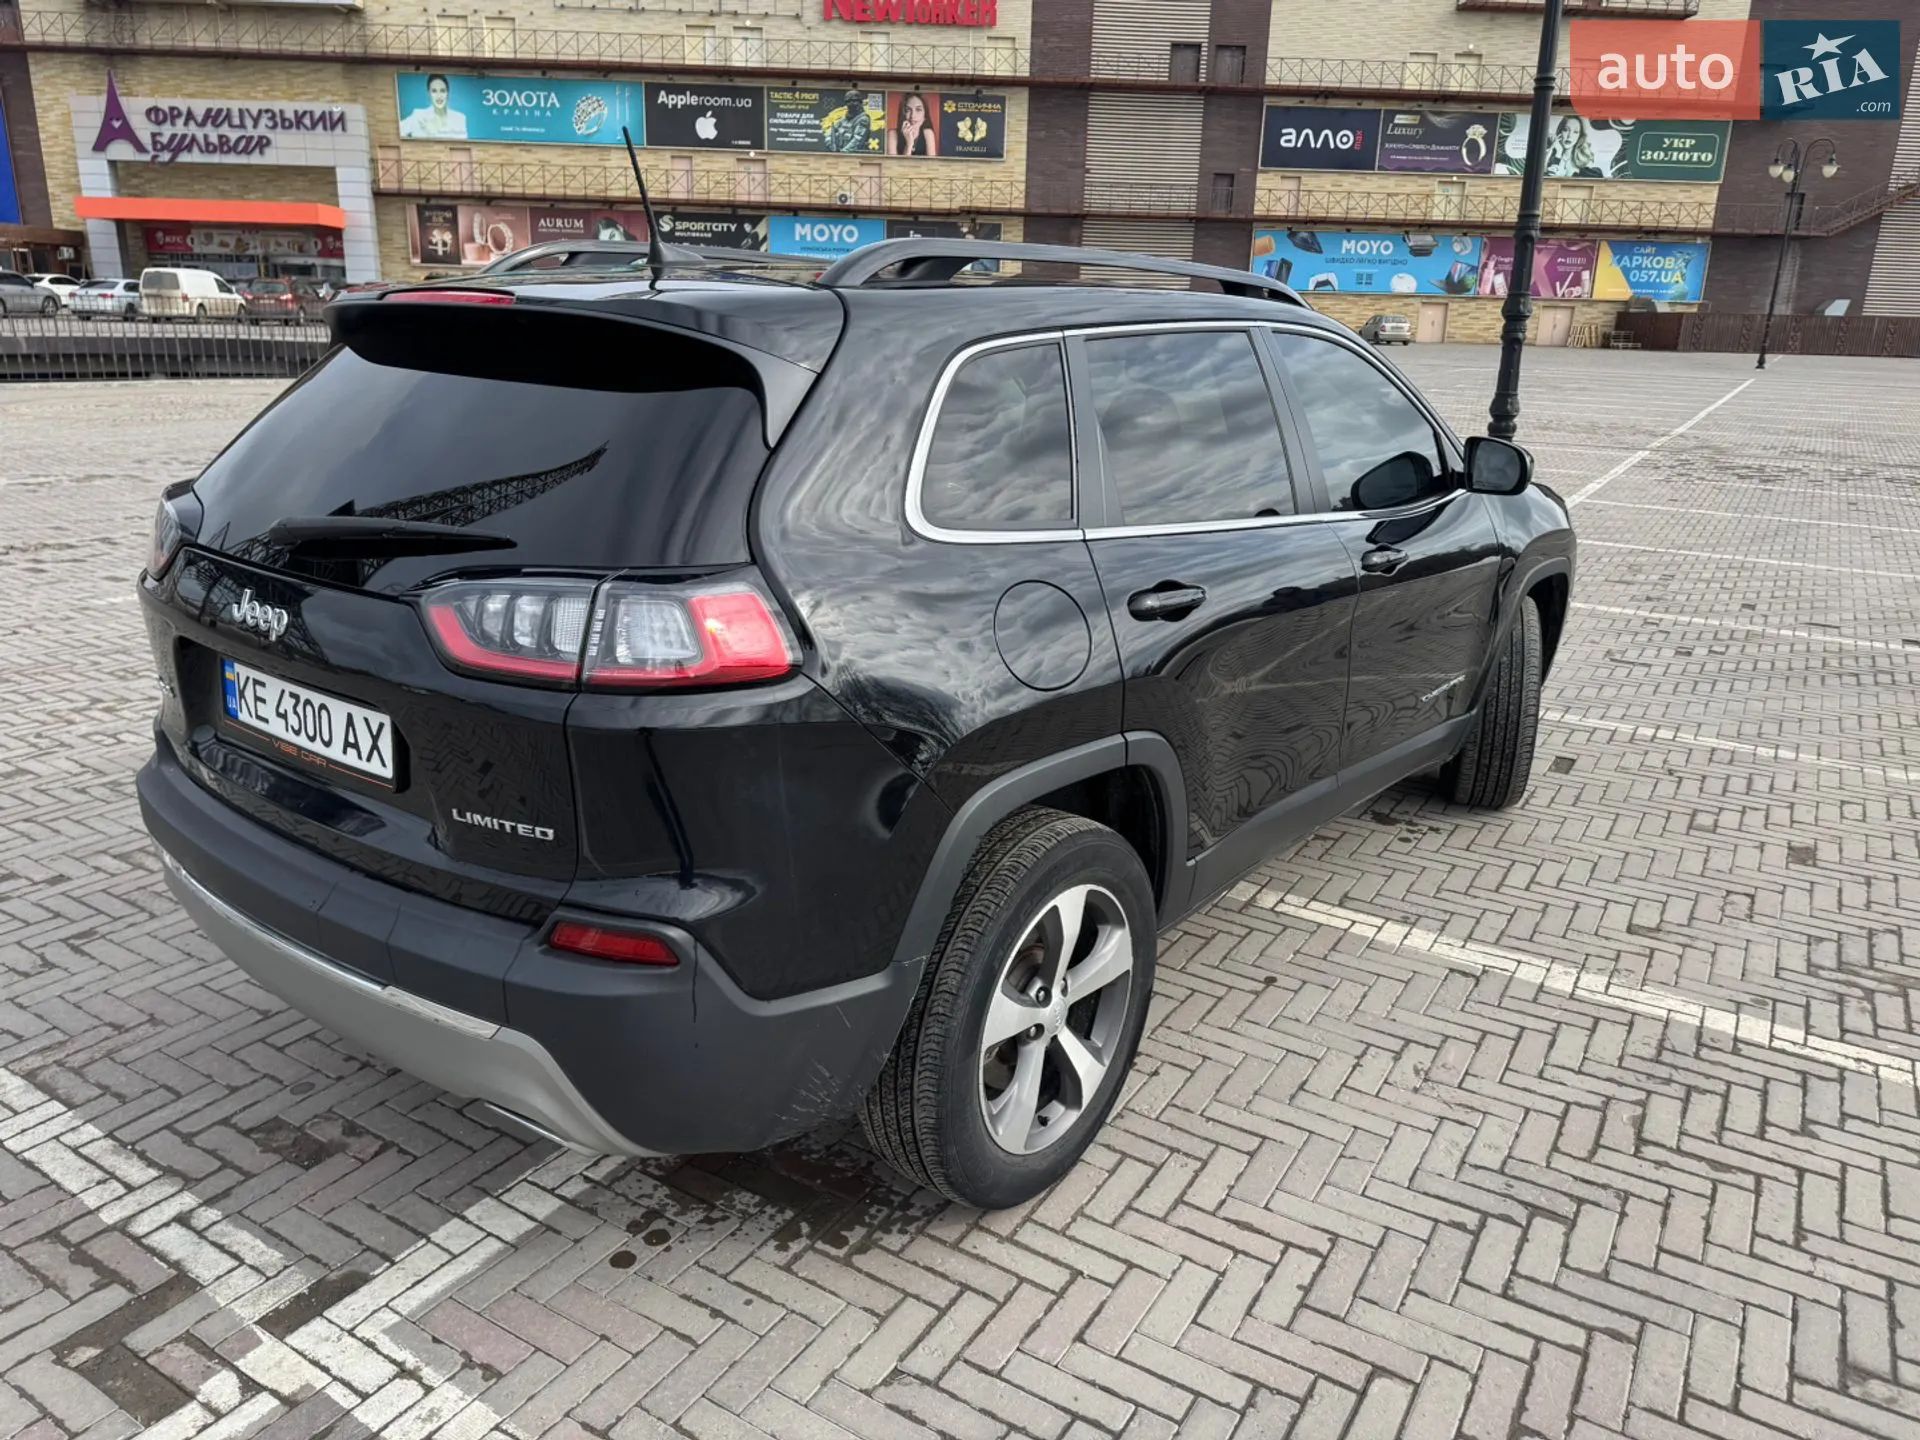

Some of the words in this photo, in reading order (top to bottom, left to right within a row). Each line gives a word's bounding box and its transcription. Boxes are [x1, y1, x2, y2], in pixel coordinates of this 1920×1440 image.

[482, 89, 560, 108] ЗОЛОТА
[657, 89, 752, 109] Appleroom.ua
[145, 105, 347, 132] ФРАНЦУЗЬКИЙ
[1386, 123, 1424, 139] Luxury
[1662, 138, 1696, 149] УКР
[1640, 151, 1713, 163] ЗОЛОТО
[538, 217, 584, 228] AURUM
[795, 223, 859, 243] MOYO
[1341, 239, 1394, 255] MOYO
[1629, 270, 1684, 284] 057.UA
[231, 586, 288, 641] Jeep
[236, 672, 269, 724] KE
[275, 688, 333, 748] 4300
[342, 711, 387, 768] AX
[451, 807, 555, 841] LIMITED
